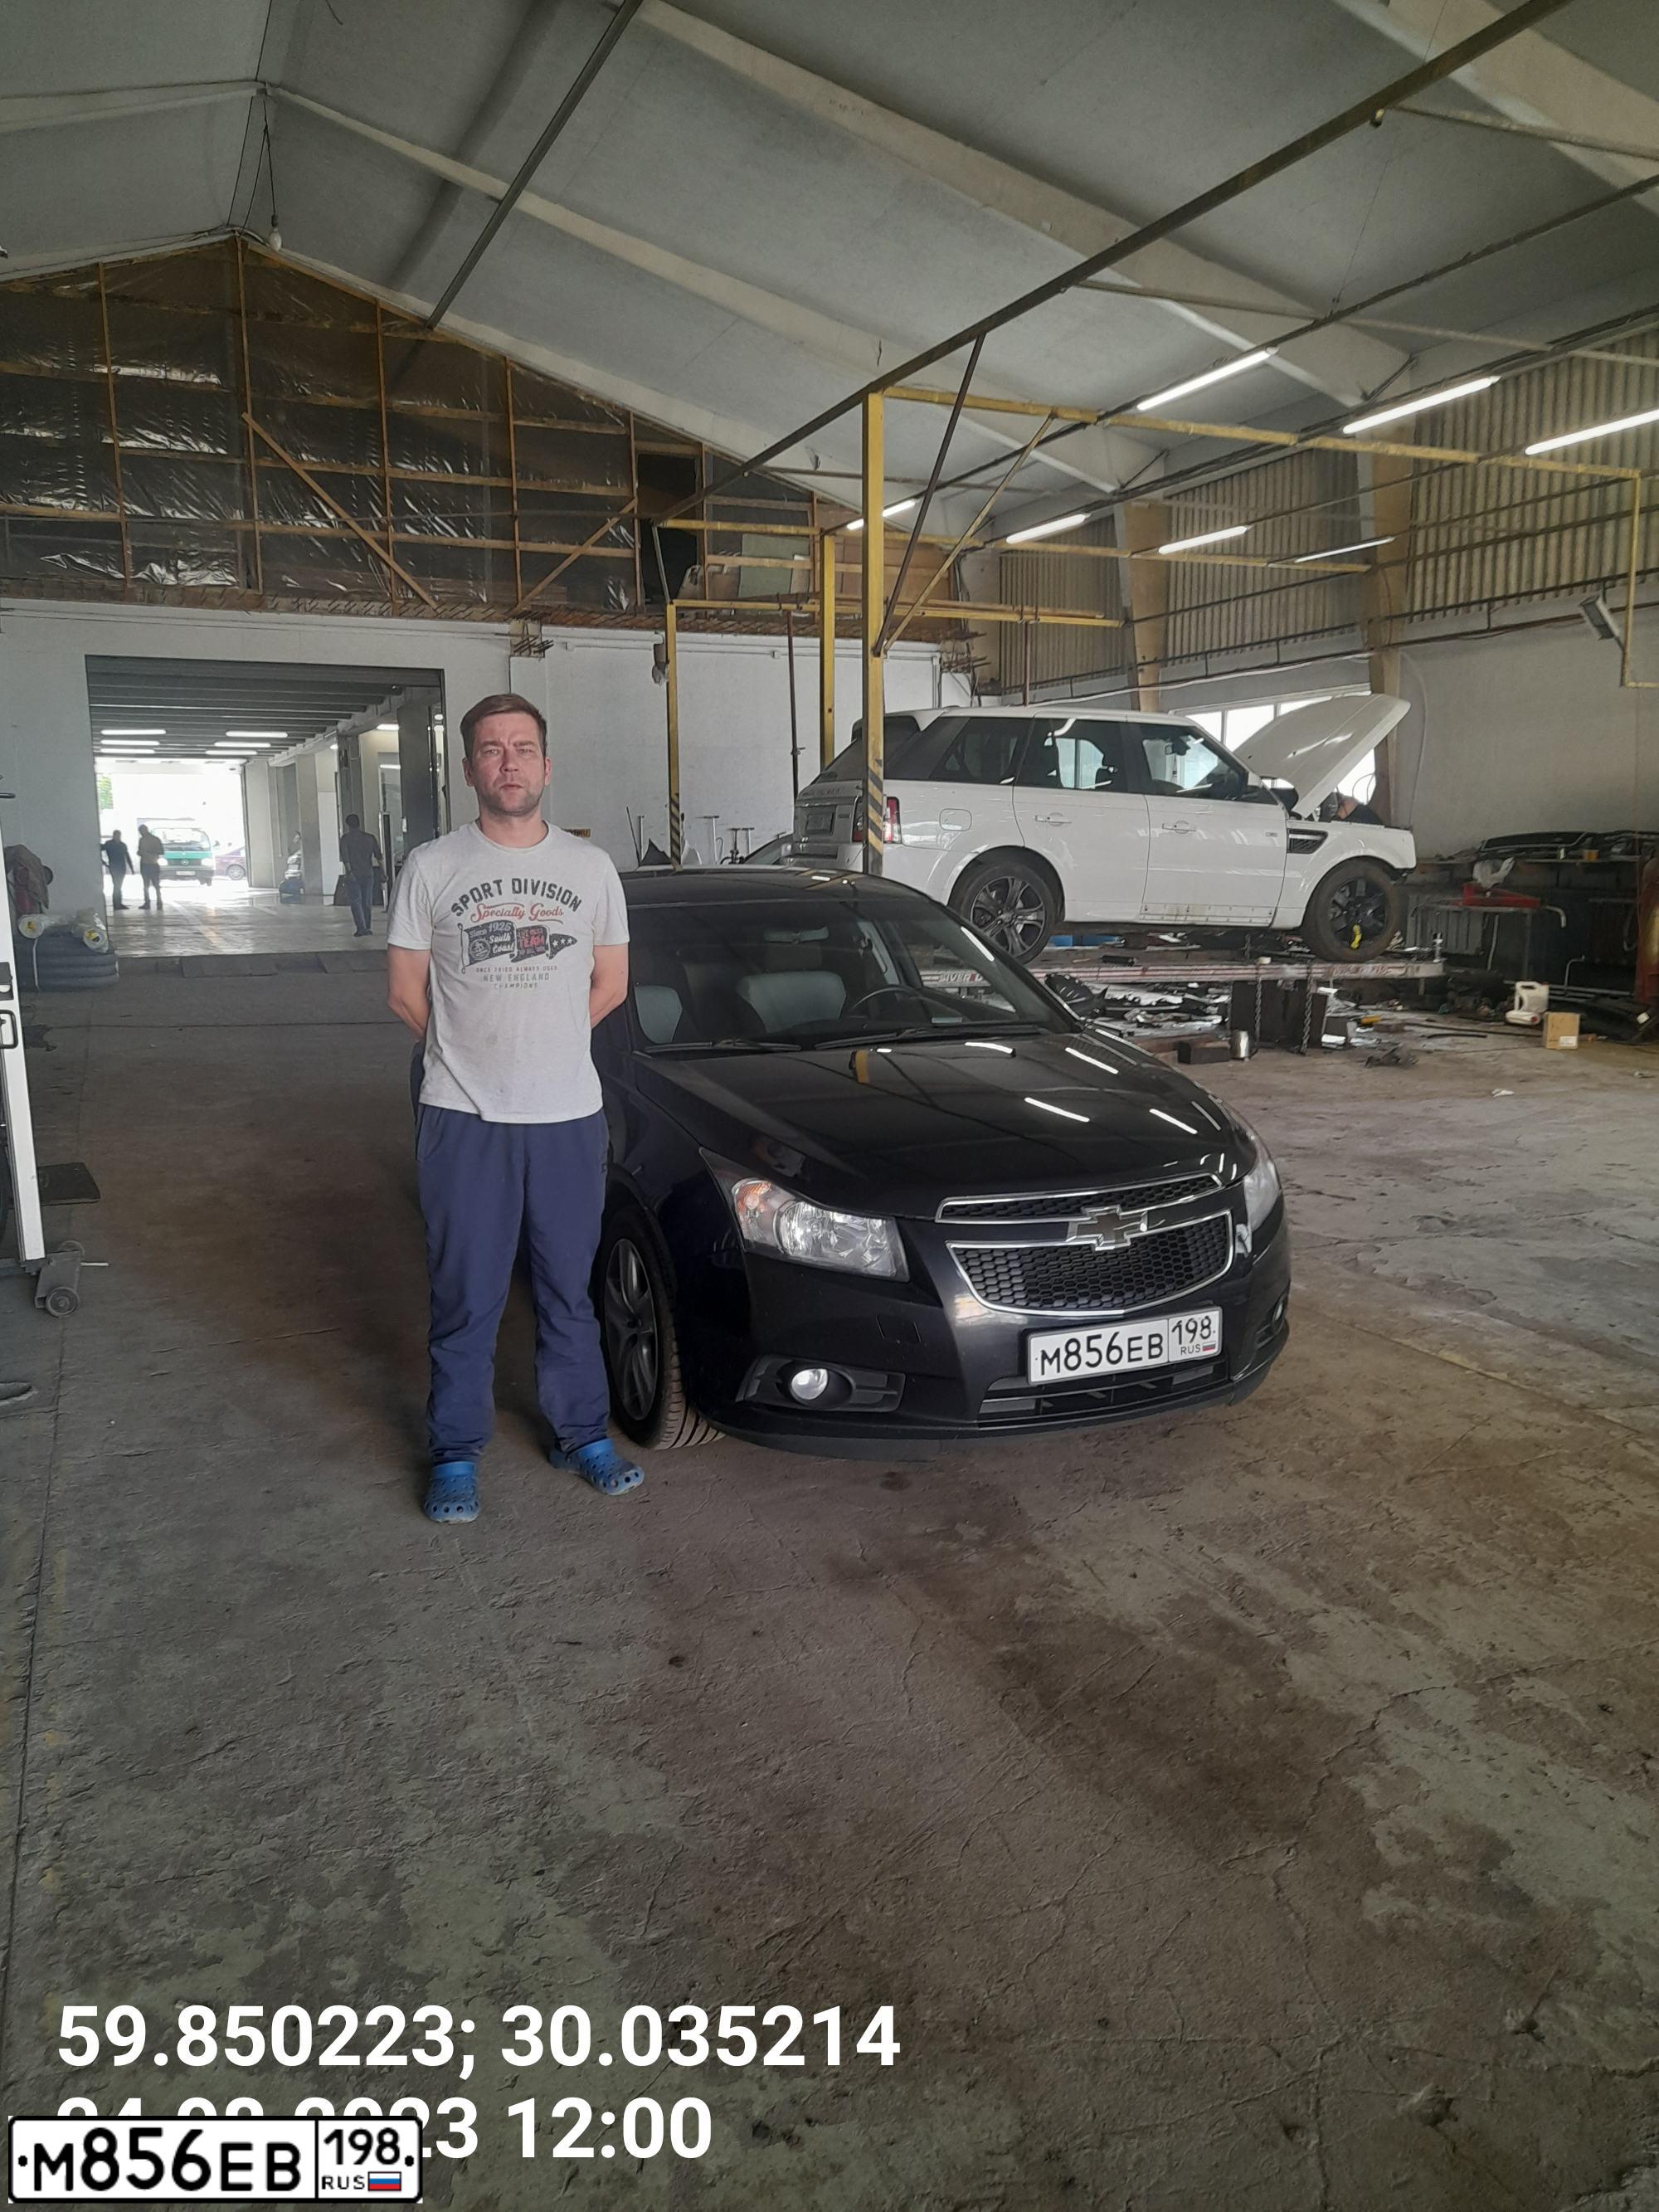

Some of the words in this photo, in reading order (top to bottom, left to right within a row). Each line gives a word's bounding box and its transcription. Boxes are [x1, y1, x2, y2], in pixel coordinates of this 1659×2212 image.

[451, 879, 503, 917] SPORT
[511, 878, 582, 912] DIVISION
[470, 903, 525, 923] Specialty
[528, 903, 564, 923] Goods
[489, 933, 511, 944] South
[483, 973, 502, 982] NEW
[508, 972, 550, 982] ENGLAND
[1171, 1315, 1212, 1346] 198
[1180, 1344, 1201, 1355] RUS
